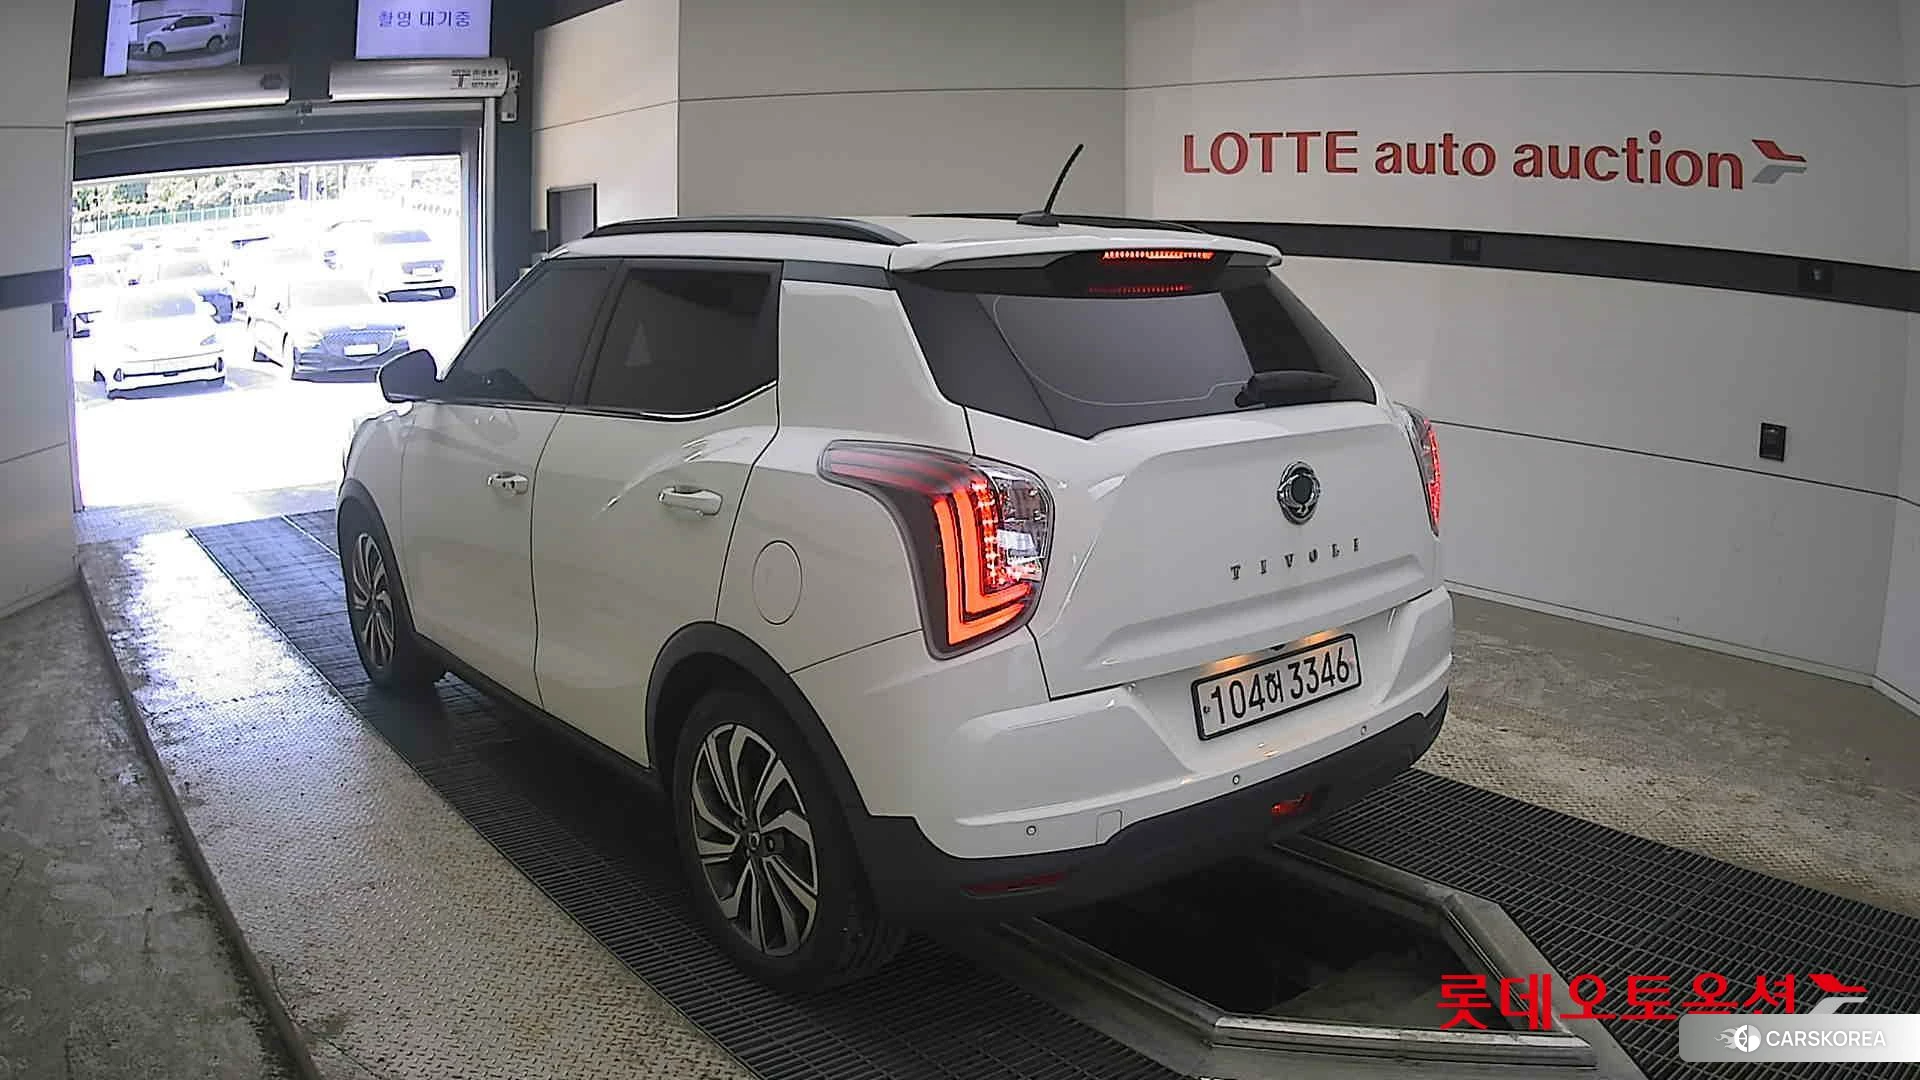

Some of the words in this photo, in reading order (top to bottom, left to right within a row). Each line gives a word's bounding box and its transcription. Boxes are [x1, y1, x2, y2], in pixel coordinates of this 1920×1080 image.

[419, 9, 472, 28] 대기중
[1184, 131, 1359, 174] LOTTE
[1375, 132, 1496, 176] auto
[1513, 130, 1744, 190] auction
[1230, 537, 1361, 581] TIVOLI
[1288, 647, 1350, 700] 3346
